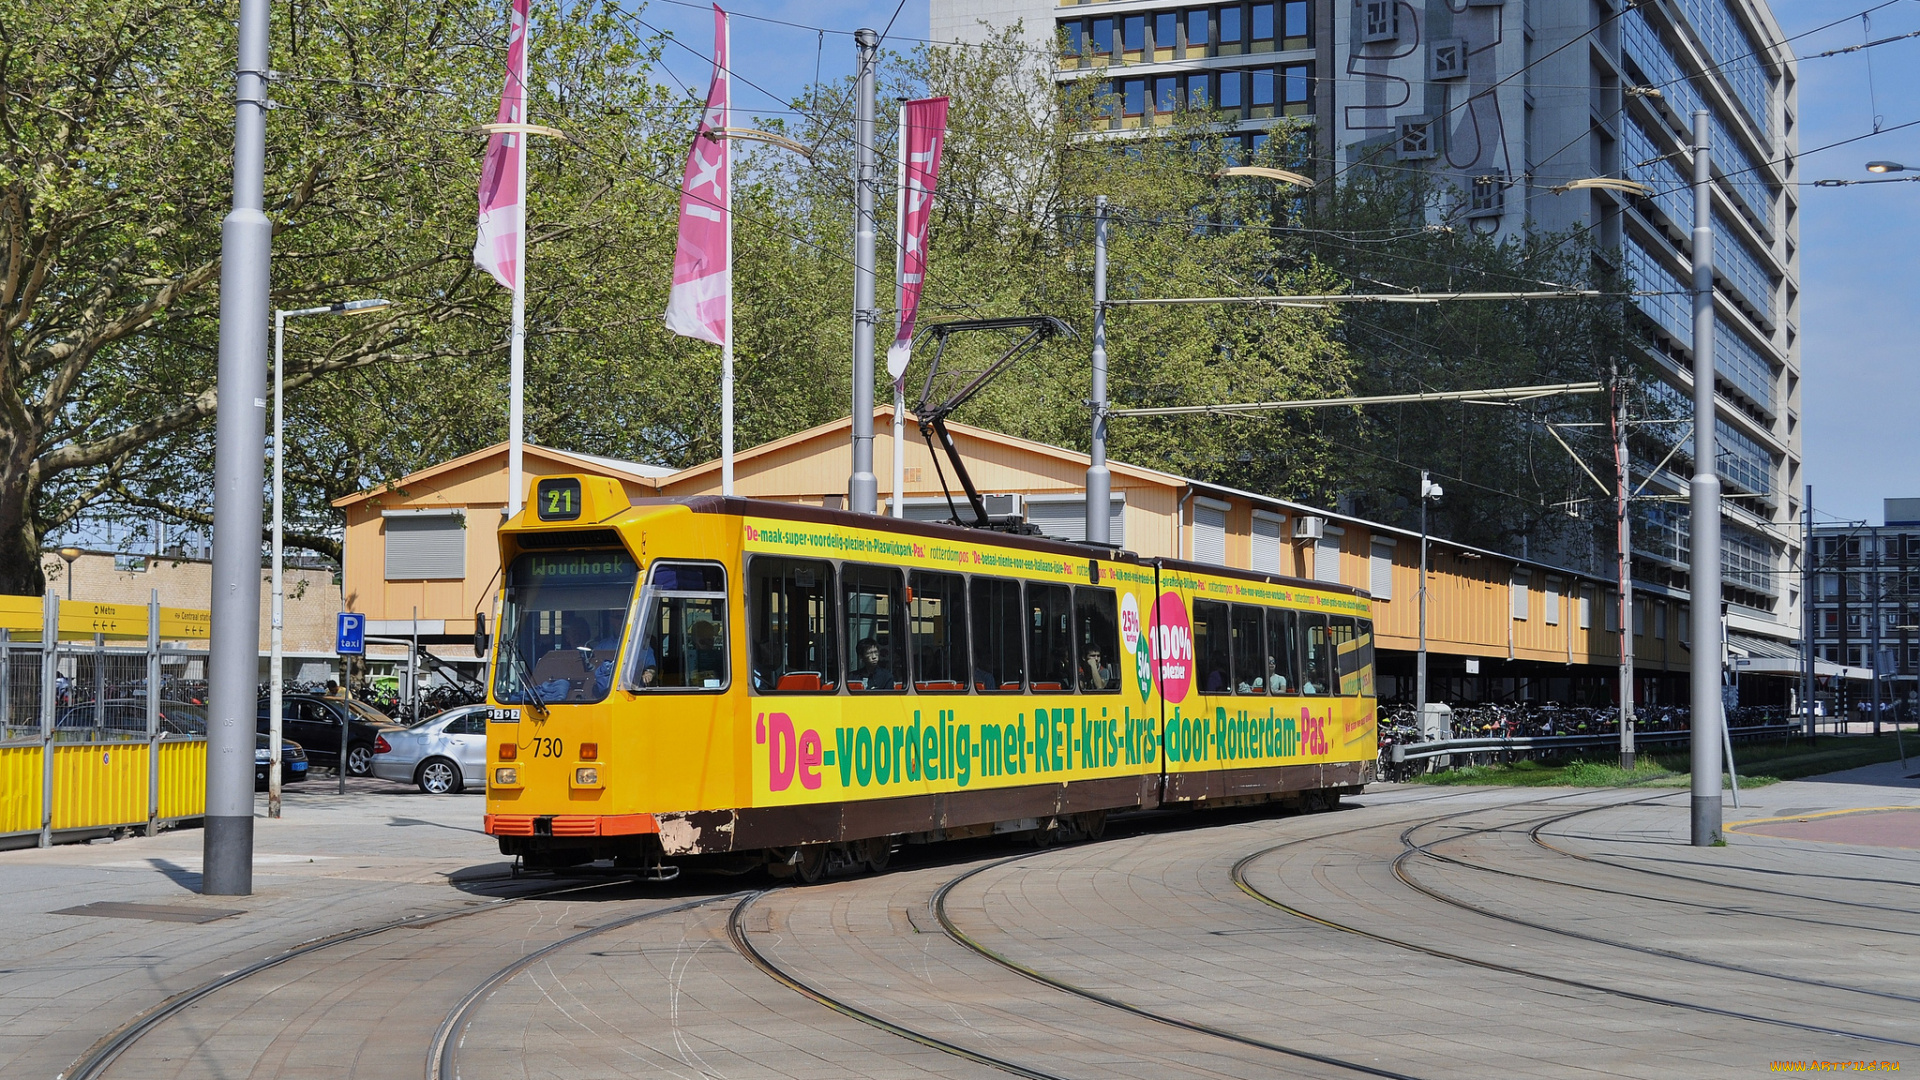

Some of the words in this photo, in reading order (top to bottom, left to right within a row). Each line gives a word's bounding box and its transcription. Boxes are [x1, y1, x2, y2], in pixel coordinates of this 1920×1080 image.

[902, 136, 937, 285] TAXI
[548, 489, 571, 513] 21
[531, 555, 623, 576] Woudhoek
[100, 605, 116, 615] Metro
[342, 616, 358, 636] P
[1122, 610, 1139, 632] 25%
[341, 639, 359, 648] taxi
[487, 710, 519, 718] 9292
[533, 738, 563, 758] 730
